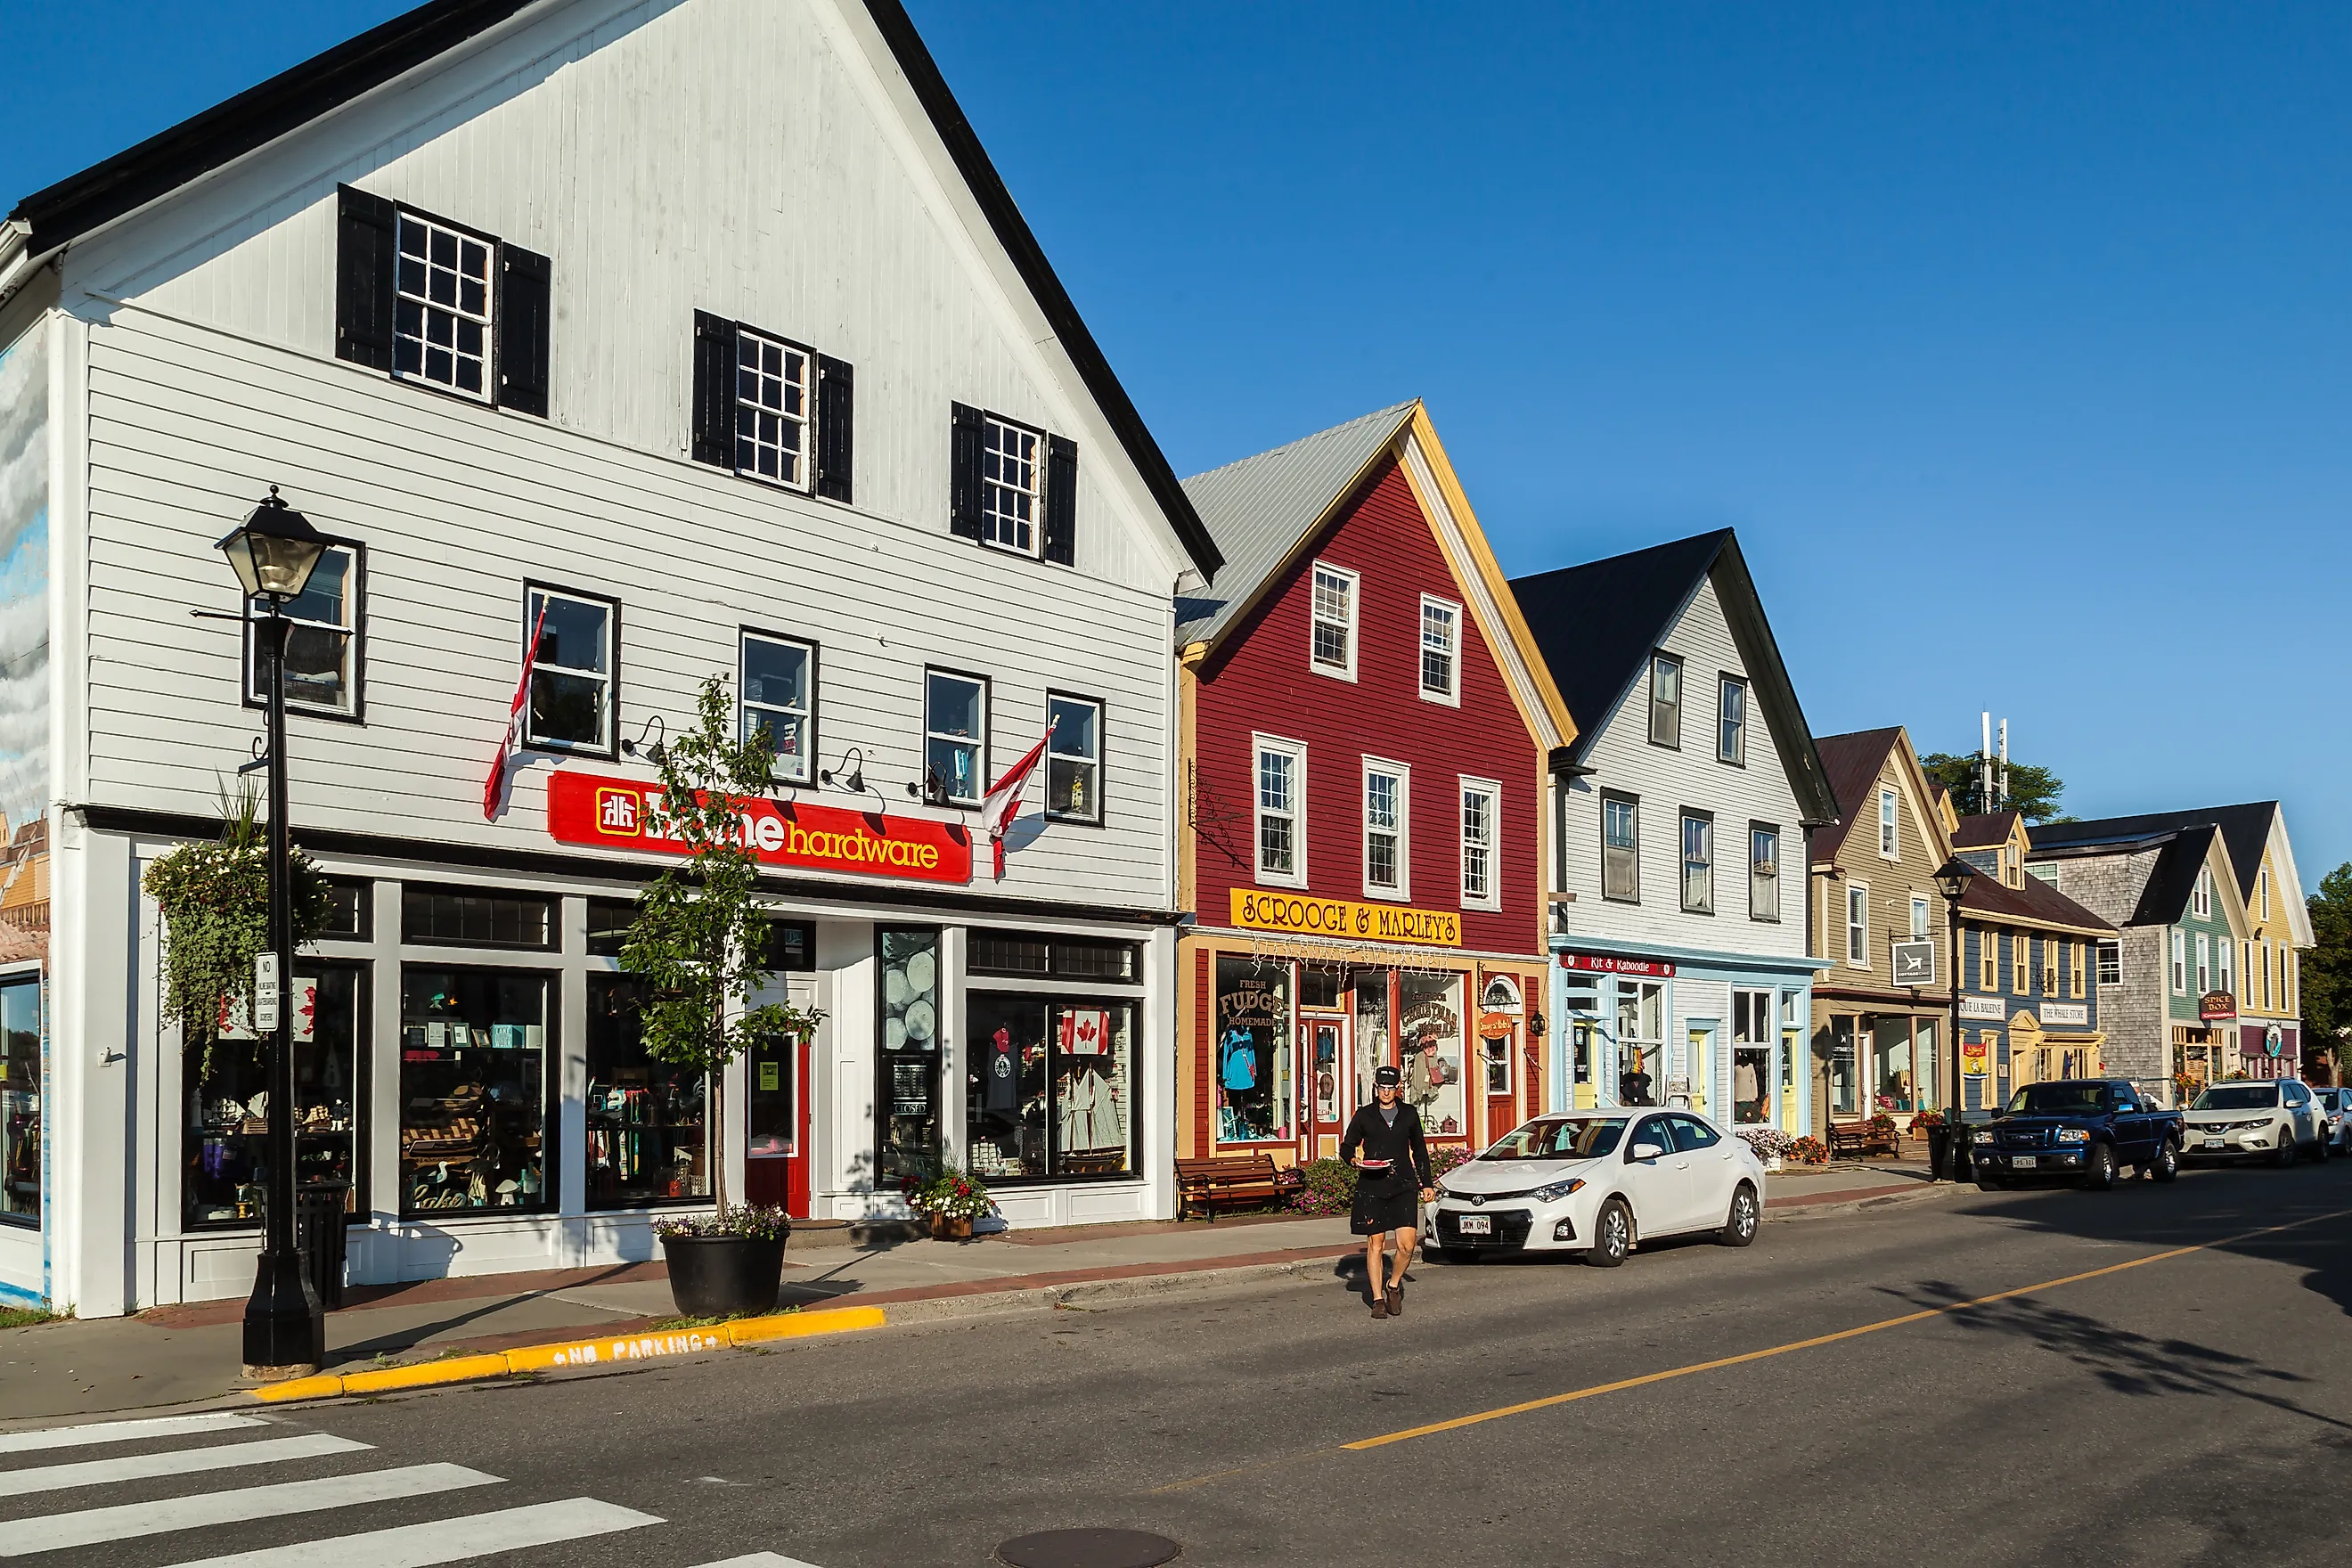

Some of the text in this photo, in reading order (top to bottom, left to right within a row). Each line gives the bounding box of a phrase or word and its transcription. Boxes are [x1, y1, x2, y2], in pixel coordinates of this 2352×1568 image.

[787, 820, 939, 869] hardware
[1243, 894, 1456, 941] SCROOGE & MARLEY'S
[262, 960, 271, 973] NO
[1590, 957, 1650, 972] Kit & Kaboodle
[1239, 979, 1266, 989] FRESH
[1412, 992, 1447, 1002] 2nd FLOOR
[2204, 996, 2231, 1004] SPICE
[1220, 991, 1285, 1017] FUDGE
[1973, 1002, 1980, 1013] LA
[1981, 1002, 2002, 1015] BALEINE
[2209, 1003, 2228, 1011] BOX
[1401, 1002, 1458, 1030] CHRISTMAS
[2044, 1009, 2053, 1018] THE
[2069, 1009, 2084, 1019] STORE
[1229, 1017, 1278, 1026] HOMEMADE
[495, 1026, 510, 1034] LAKE
[894, 1104, 926, 1113] CLOSED
[1477, 1221, 1489, 1229] 094
[568, 1335, 702, 1364] NO PARKING
